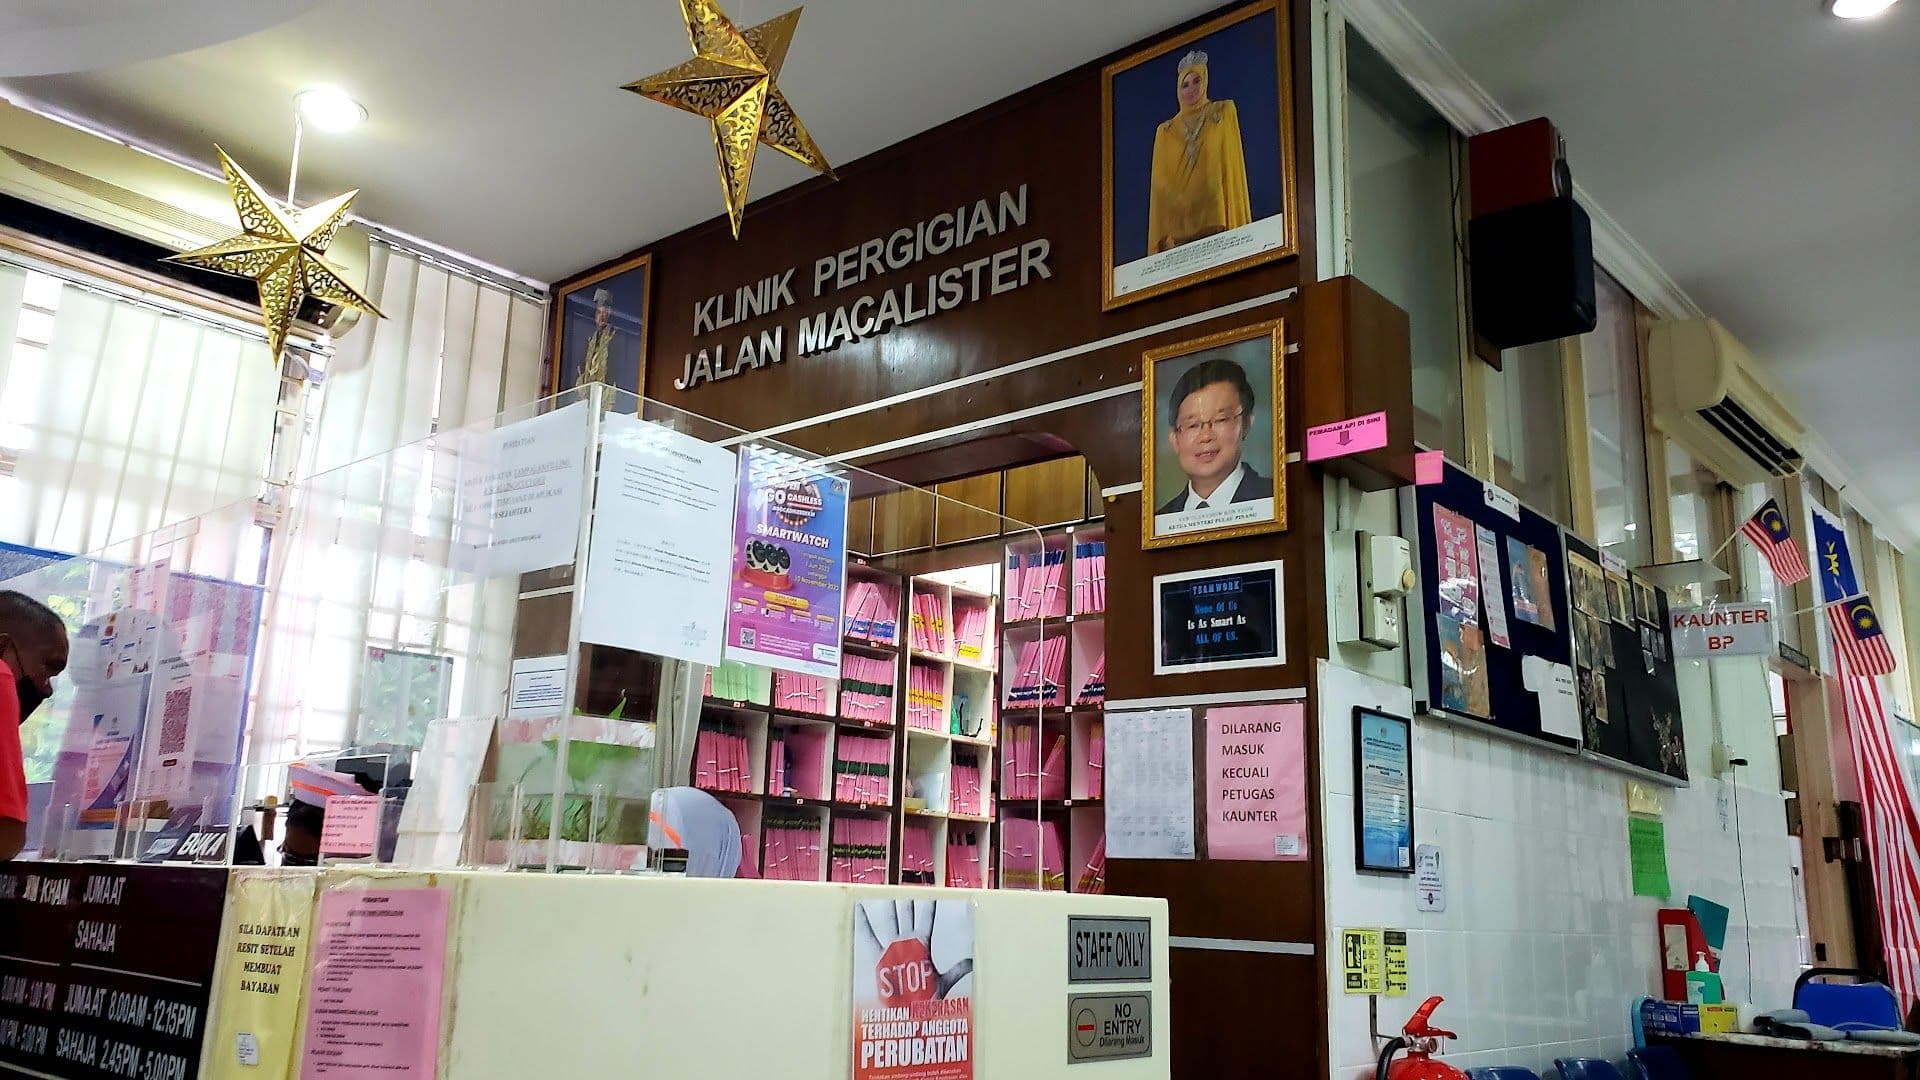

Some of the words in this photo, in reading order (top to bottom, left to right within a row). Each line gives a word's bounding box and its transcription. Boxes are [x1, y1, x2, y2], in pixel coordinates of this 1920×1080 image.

[693, 267, 796, 336] KLINIK
[813, 184, 1028, 296] PERGIGIAN
[673, 325, 784, 391] JALAN
[797, 238, 1053, 356] MACALISTER
[1309, 424, 1343, 436] PEMADAM
[1345, 421, 1356, 430] API
[1357, 419, 1365, 427] DI
[1366, 416, 1381, 425] SINI
[787, 493, 823, 506] CASHLESS
[756, 523, 829, 549] SMARTWATCH
[1192, 580, 1241, 596] TEAMWORK
[1187, 619, 1195, 630] Is
[1198, 618, 1208, 629] As
[1210, 616, 1233, 628] Smart
[1236, 614, 1247, 626] As
[1673, 608, 1769, 628] KAUNTER
[1195, 633, 1209, 645] ALL
[1708, 635, 1736, 650] BP
[1221, 721, 1282, 735] DILARANG
[1222, 743, 1265, 756] MASUK
[1222, 767, 1269, 779] KECUALI
[1222, 788, 1275, 801] PETUGAS
[1222, 810, 1278, 822] KAUNTER
[177, 832, 227, 857] BUKA
[82, 875, 127, 906] JUMAAT
[75, 919, 117, 953] SAHAJA
[239, 924, 255, 935] SILA
[255, 925, 301, 938] DAPATKAN
[236, 942, 260, 954] RESIT
[260, 943, 296, 957] SETELAH
[1076, 931, 1112, 968] STAFF
[1115, 931, 1145, 968] ONLY
[243, 961, 282, 976] MEMBUAT
[879, 959, 934, 999] STOP
[240, 980, 280, 995] BAYARAN
[63, 983, 108, 1018] JUMAAT
[861, 1007, 910, 1023] HENTIKAN
[1114, 1003, 1132, 1018] NO
[861, 1021, 920, 1040] TERHADAP
[921, 1018, 969, 1037] ANGGOTA
[1104, 1020, 1142, 1036] ENTRY
[56, 1027, 97, 1066] SAHAJA
[861, 1035, 968, 1069] PERUBATAN
